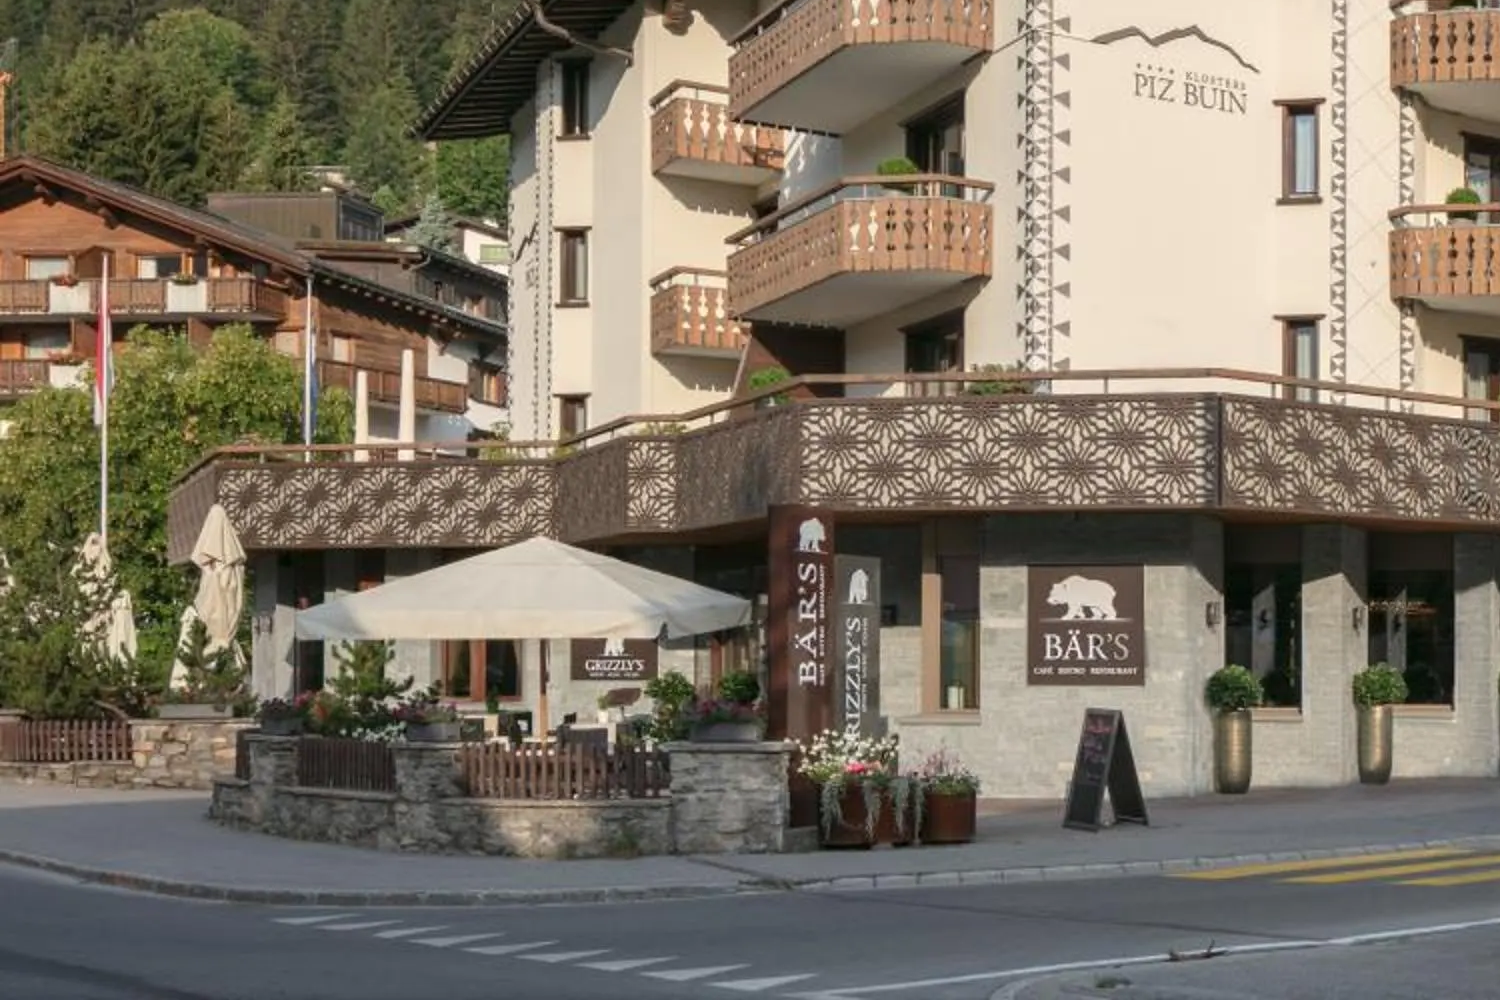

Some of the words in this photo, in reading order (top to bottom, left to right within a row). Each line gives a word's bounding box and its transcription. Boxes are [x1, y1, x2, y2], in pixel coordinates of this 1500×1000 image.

[1134, 72, 1175, 103] PIZ
[1183, 81, 1247, 115] BUIN
[1185, 71, 1246, 91] KLOSTERS
[795, 562, 818, 686] BÄR'S
[1043, 629, 1130, 661] BÄR'S
[845, 616, 861, 741] RIZZLY'S
